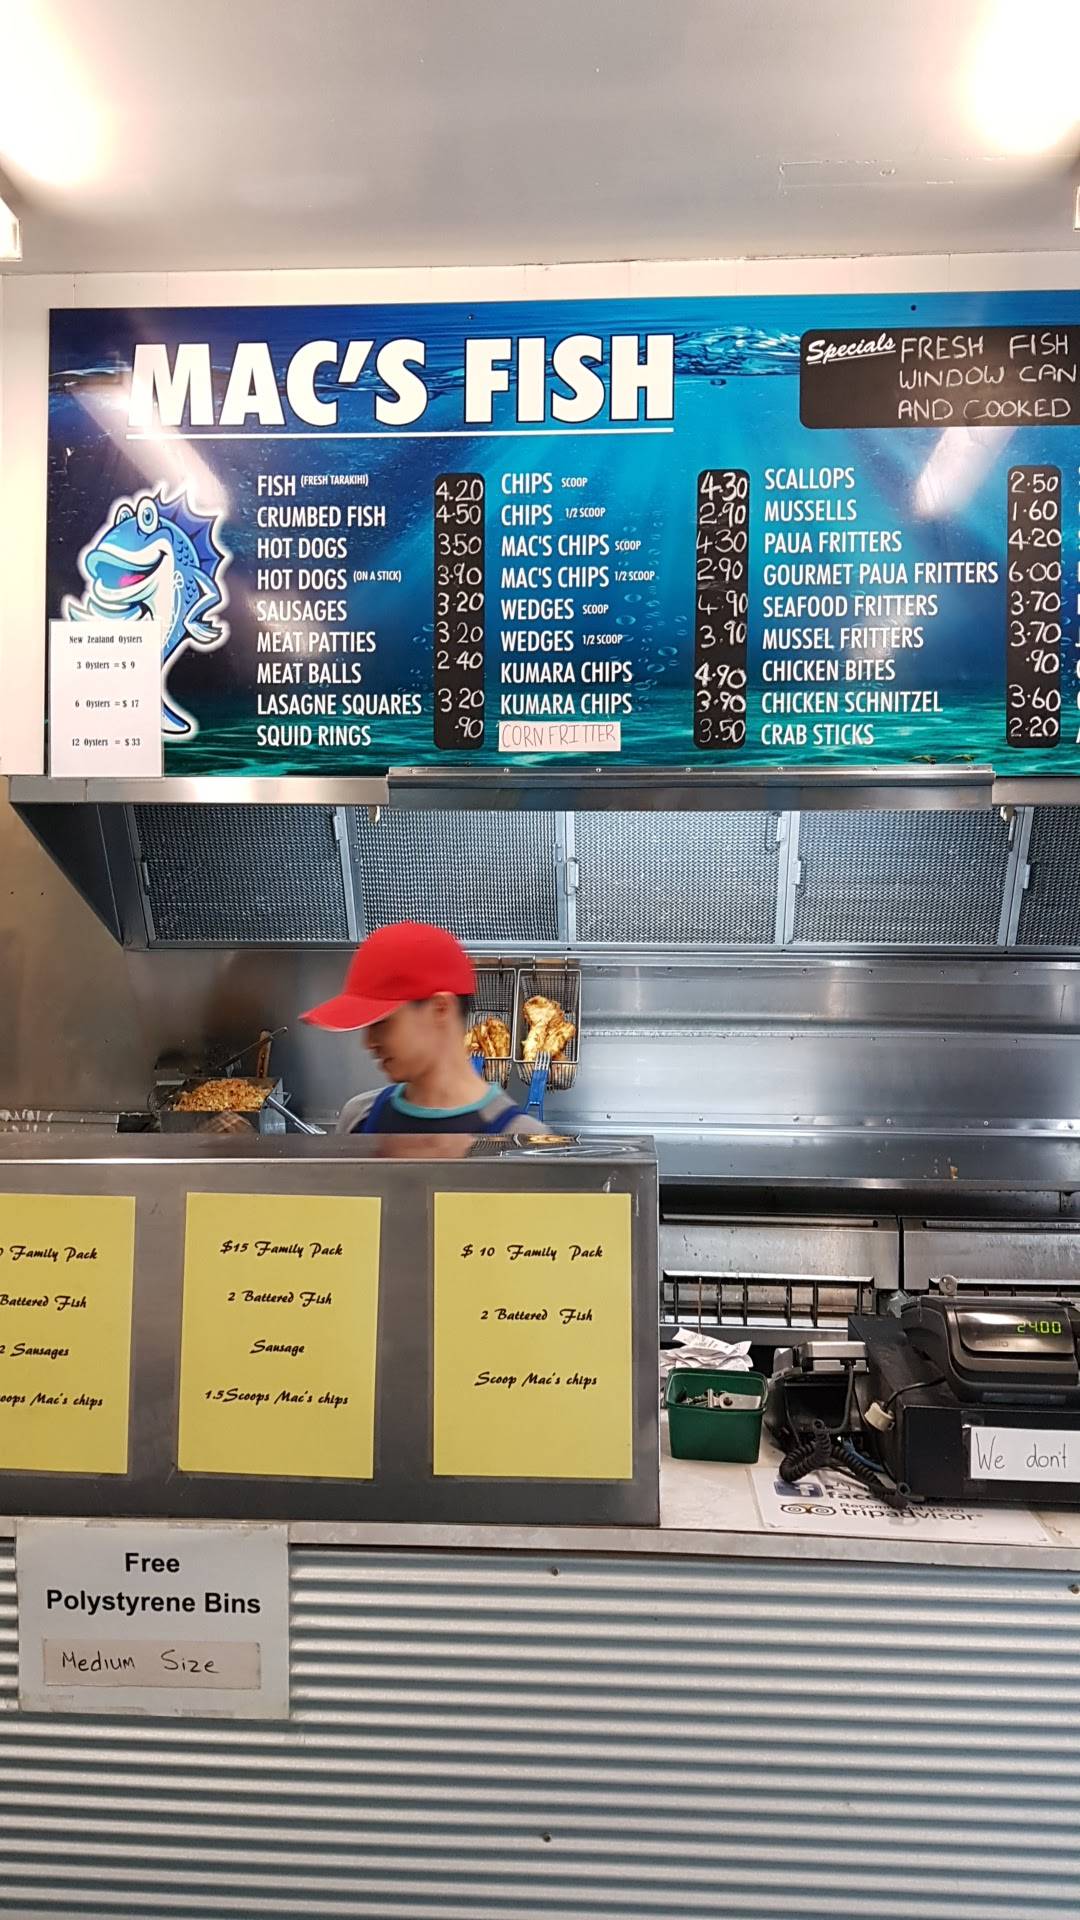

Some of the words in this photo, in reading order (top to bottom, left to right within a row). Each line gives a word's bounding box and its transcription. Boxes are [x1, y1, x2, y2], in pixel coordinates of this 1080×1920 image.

[806, 332, 896, 364] Specials
[901, 335, 984, 363] FRESH
[1009, 333, 1068, 359] FISH
[126, 337, 430, 428] MAC'S
[464, 333, 675, 424] FISH
[900, 365, 1005, 389] WINDOW
[1019, 364, 1077, 383] CAN
[898, 398, 953, 421] AND
[963, 398, 1072, 420] COOKED
[257, 475, 296, 497] FISH
[300, 474, 328, 487] (FRESH
[330, 474, 369, 487] TARAKIHI)
[501, 472, 553, 495] CHIPS
[561, 477, 588, 488] SCOOP
[700, 471, 748, 501] 4.30
[764, 467, 855, 490] SCALLOPS
[1010, 471, 1059, 493] 2.50
[435, 479, 484, 502] 4.20
[257, 506, 341, 527] CRUMBED
[347, 505, 386, 527] FISH
[435, 504, 482, 526] 4.50
[501, 505, 553, 526] CHIPS
[565, 507, 578, 519] 1/2
[579, 507, 606, 518] SCOOP
[699, 501, 746, 528] 2.90
[764, 499, 857, 522] MUSSELLS
[1012, 500, 1058, 521] 1.60
[257, 537, 293, 559] HOT
[298, 537, 348, 559] DOGS
[501, 535, 552, 557] MAC'S
[558, 534, 609, 556] CHIPS
[614, 540, 642, 551] SCOOP
[695, 529, 747, 555] 4.30
[764, 531, 813, 554] PAUA
[819, 531, 902, 553] FRITTERS
[1008, 527, 1062, 551] 4.20
[257, 569, 293, 590] HOT
[298, 568, 348, 590] DOGS
[353, 570, 369, 583] (ON
[369, 570, 376, 581] A
[377, 570, 402, 582] STICK)
[437, 562, 482, 586] 3.90
[501, 567, 552, 589] MAC'S
[558, 566, 609, 588] CHIPS
[614, 570, 627, 582] 1/2
[628, 570, 655, 581] SCOOP
[697, 557, 744, 583] 2.90
[763, 563, 853, 586] GOURMET
[859, 563, 908, 585] PAUA
[914, 562, 999, 584] FRITTERS
[1008, 560, 1062, 583] 6.00
[257, 600, 348, 621] SAUSAGES
[500, 599, 575, 621] WEDGES
[582, 604, 609, 615] SCOOP
[762, 596, 848, 618] SEAFOOD
[854, 595, 938, 617] FRITTERS
[1010, 591, 1061, 615] 3.70
[69, 635, 83, 644] New
[87, 635, 114, 644] Zealand
[118, 635, 143, 644] Oysters
[257, 631, 302, 652] MEAT
[308, 631, 377, 653] PATTIES
[500, 630, 574, 652] WEDGES
[582, 634, 595, 646] 1/2
[596, 634, 623, 645] SCOOP
[700, 620, 747, 649] 3.90
[762, 628, 834, 650] MUSSEL
[840, 627, 924, 649] FRITTERS
[1010, 621, 1062, 647] 3.70
[85, 661, 110, 670] Oysters
[500, 662, 576, 684] KUMARA
[581, 661, 633, 683] CHIPS
[762, 660, 839, 682] CHICKEN
[845, 659, 896, 681] BITES
[1026, 649, 1059, 674] .90
[257, 663, 302, 684] MEAT
[308, 663, 362, 684] BALLS
[694, 662, 747, 689] 4.90
[86, 700, 110, 709] Oysters
[257, 694, 337, 715] LASAGNE
[342, 694, 422, 716] SQUARES
[500, 693, 576, 715] KUMARA
[580, 692, 633, 714] CHIPS
[696, 690, 747, 713] 3.90
[761, 692, 839, 714] CHICKEN
[844, 691, 944, 713] SCHNITZEL
[1009, 684, 1061, 712] 3.60
[256, 725, 313, 747] SQUID
[318, 725, 372, 746] RINGS
[502, 724, 544, 748] CORN
[549, 723, 616, 744] FRITTER
[699, 719, 747, 744] 3.50
[760, 723, 807, 746] CRAB
[813, 723, 875, 745] STICKS
[1009, 716, 1059, 738] 2.20
[84, 738, 109, 747] Oysters
[10, 1245, 59, 1262] Family
[64, 1246, 98, 1262] Pack
[220, 1239, 249, 1255] $15
[254, 1240, 304, 1258] Family
[309, 1241, 343, 1258] Pack
[506, 1244, 557, 1260] Family
[569, 1245, 603, 1261] Pack
[0, 1294, 49, 1307] Battered
[54, 1295, 87, 1311] Fish
[228, 1291, 236, 1302] 2
[241, 1289, 294, 1304] Battered
[299, 1291, 332, 1307] Fish
[480, 1310, 488, 1320] 2
[494, 1308, 548, 1321] Battered
[559, 1308, 593, 1324] Fish
[10, 1342, 70, 1359] Sausages
[249, 1339, 305, 1357] Sausage
[474, 1371, 517, 1389] Scoop
[521, 1372, 561, 1388] Mac's
[566, 1372, 597, 1389] chips
[0, 1394, 25, 1407] oops
[29, 1392, 68, 1406] Mac's
[73, 1393, 103, 1410] chips
[274, 1390, 313, 1405] Mac's
[318, 1391, 349, 1409] chips
[975, 1431, 1006, 1471] We
[1026, 1442, 1067, 1469] don't
[125, 1552, 180, 1573] Free
[46, 1589, 196, 1616] Polystyrene
[204, 1591, 261, 1614] Bins
[61, 1650, 136, 1672] Medium
[160, 1648, 220, 1674] Size
